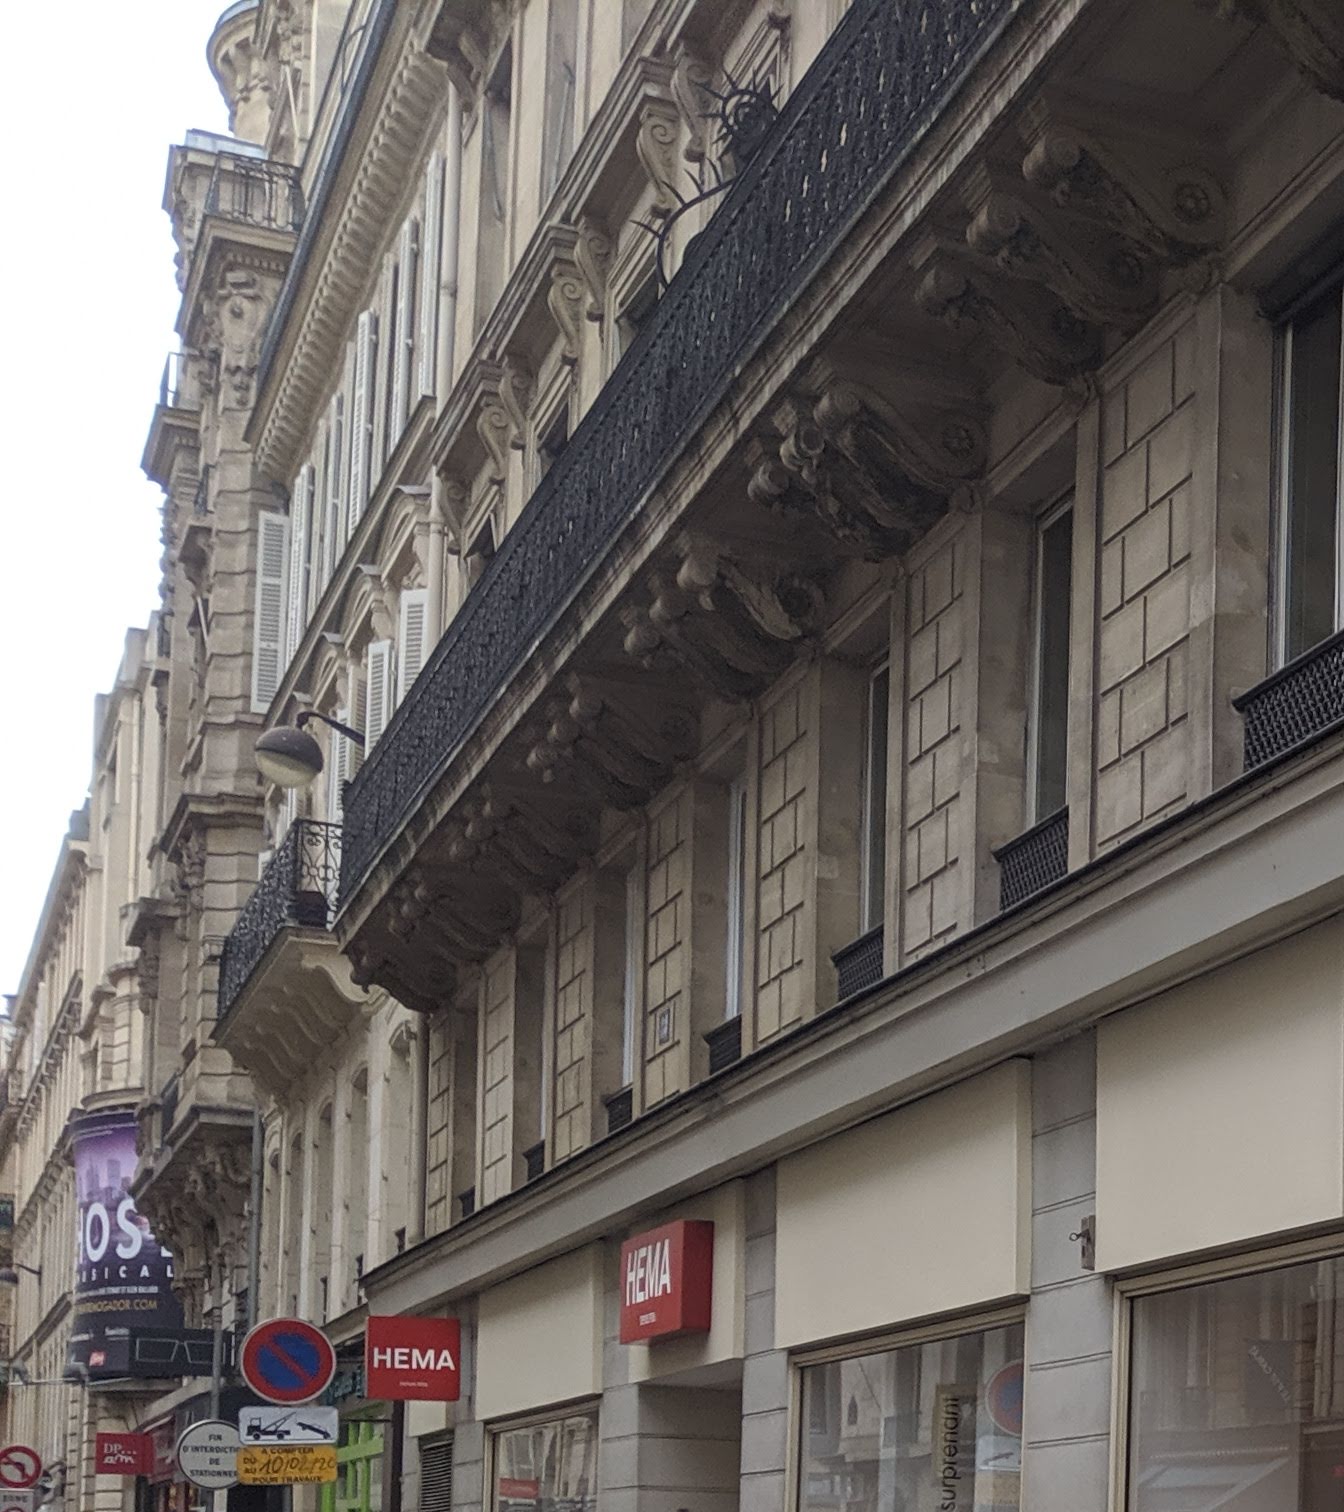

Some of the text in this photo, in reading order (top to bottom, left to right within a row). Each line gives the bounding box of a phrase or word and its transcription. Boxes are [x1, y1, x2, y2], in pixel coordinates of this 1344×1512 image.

[625, 1238, 672, 1307] HEMA
[373, 1347, 456, 1371] HEMA
[942, 1397, 961, 1512] surprenant
